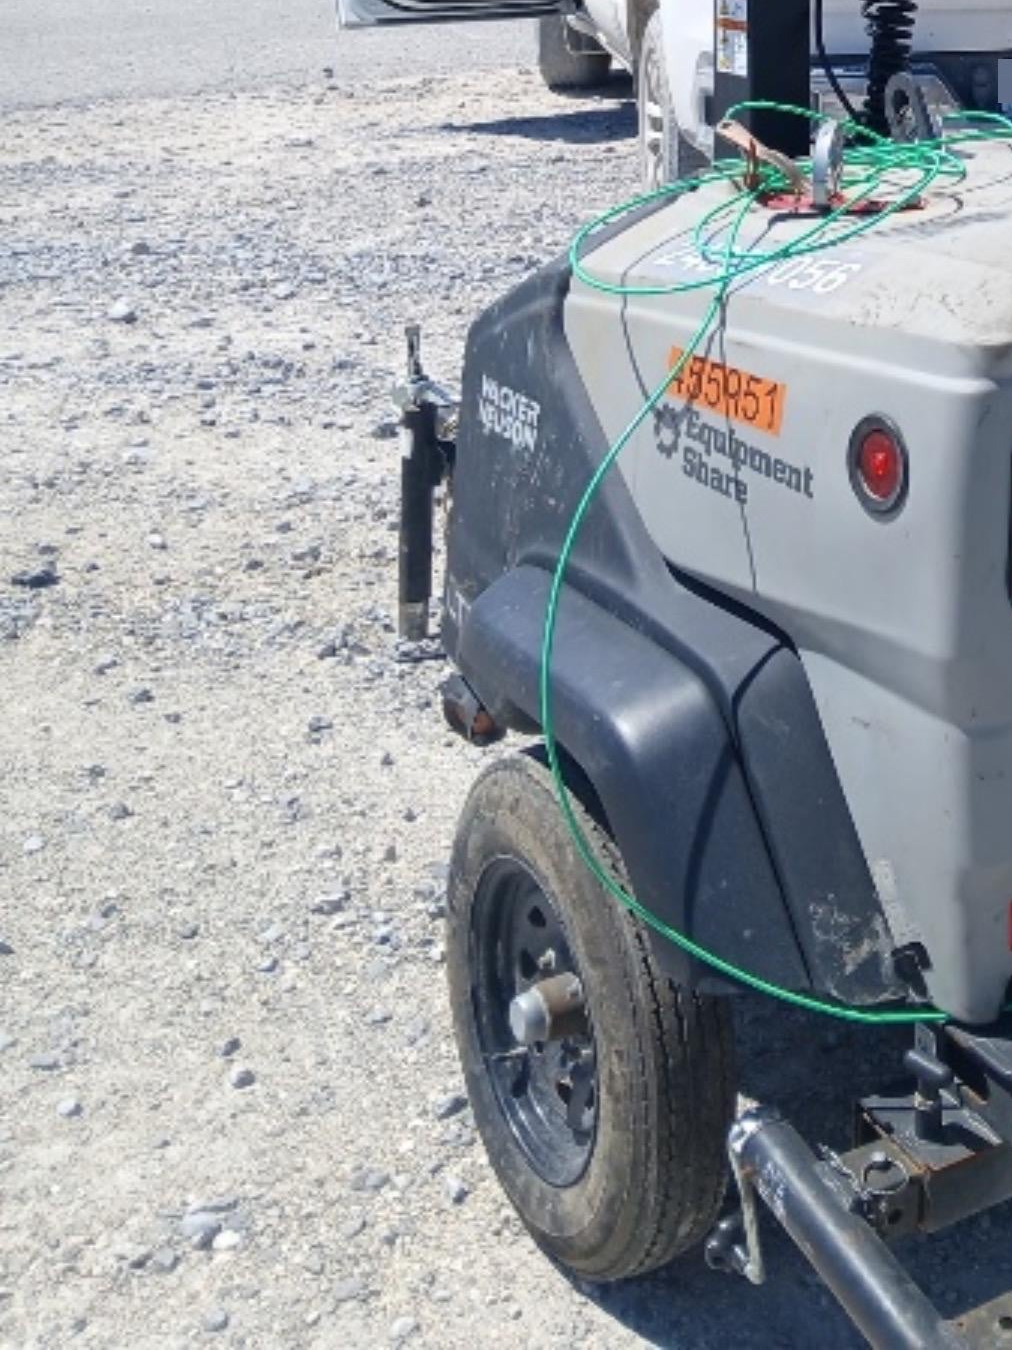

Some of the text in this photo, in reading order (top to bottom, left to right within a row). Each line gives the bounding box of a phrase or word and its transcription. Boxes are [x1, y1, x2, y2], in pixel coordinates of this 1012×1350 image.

[479, 397, 538, 453] NEUSON
[481, 373, 541, 427] WACKER
[681, 446, 749, 505] Share
[685, 406, 814, 500] Equipment
